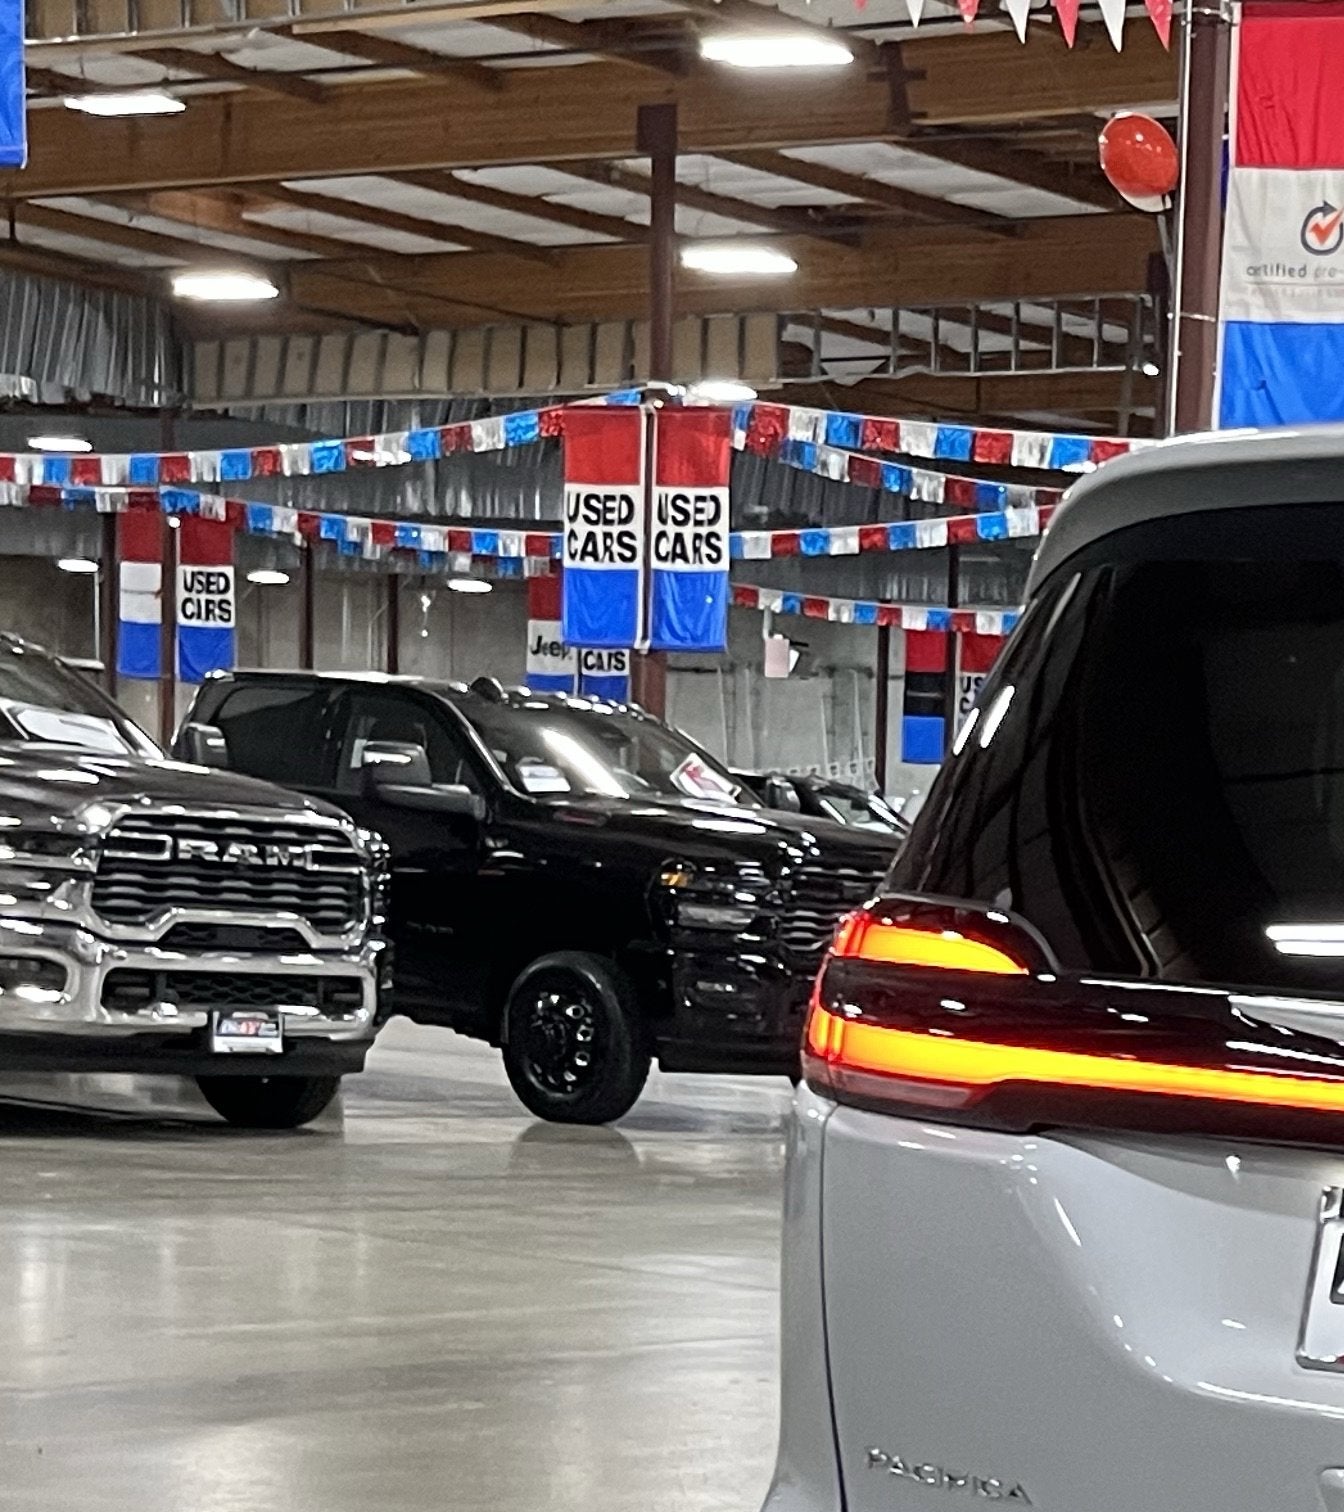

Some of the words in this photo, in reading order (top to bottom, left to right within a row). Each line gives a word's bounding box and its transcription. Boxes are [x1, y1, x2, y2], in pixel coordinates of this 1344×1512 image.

[567, 491, 635, 526] USED
[657, 493, 722, 527] USED
[567, 528, 637, 563] CARS
[654, 530, 722, 564] CARS
[183, 569, 231, 595] USED
[176, 838, 308, 867] RAM
